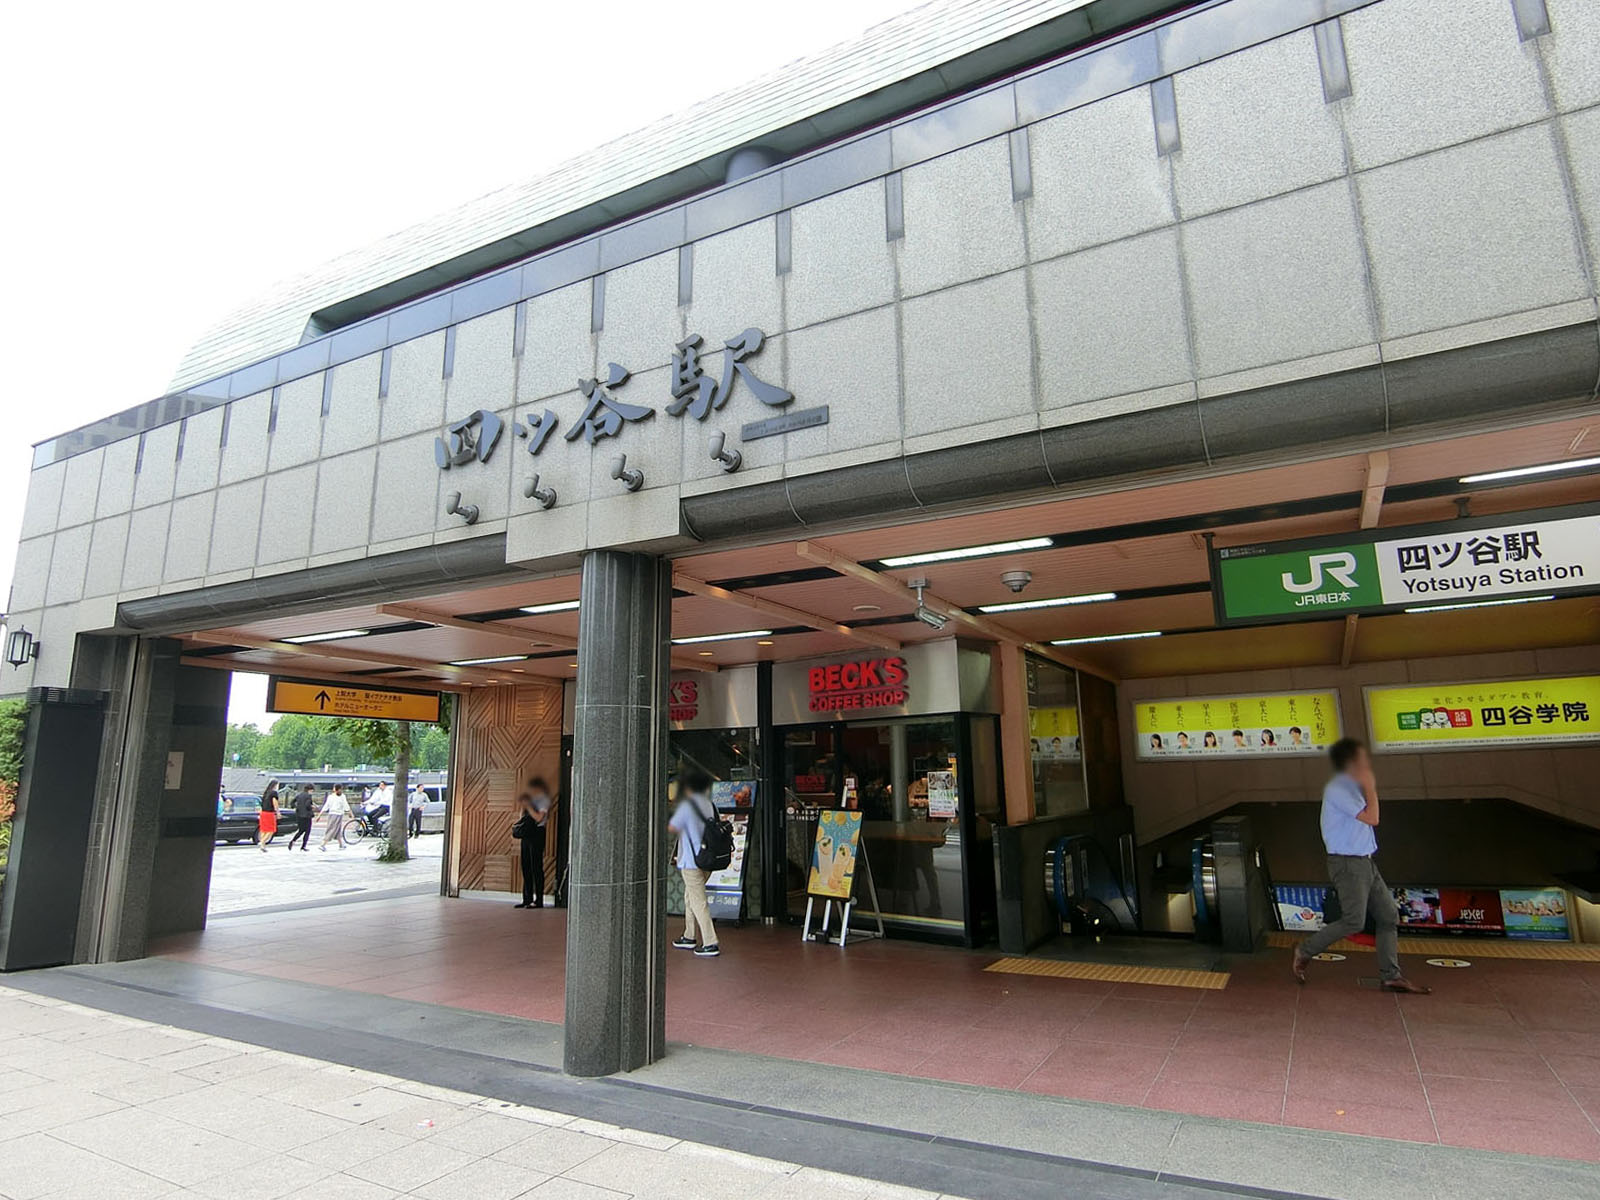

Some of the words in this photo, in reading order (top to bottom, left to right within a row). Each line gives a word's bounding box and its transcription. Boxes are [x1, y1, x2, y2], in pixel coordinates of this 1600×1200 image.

[435, 327, 795, 470] 四ツ谷駅
[1397, 531, 1543, 574] 四ツ谷駅
[1282, 552, 1359, 593] JR
[1402, 574, 1492, 594] Yotsuya
[1499, 564, 1584, 585] Station
[1295, 591, 1351, 606] JR東日本
[808, 657, 908, 692] BECK'S
[808, 694, 861, 712] COFFEE
[863, 690, 906, 708] SHOP
[1481, 702, 1590, 727] 四谷学院
